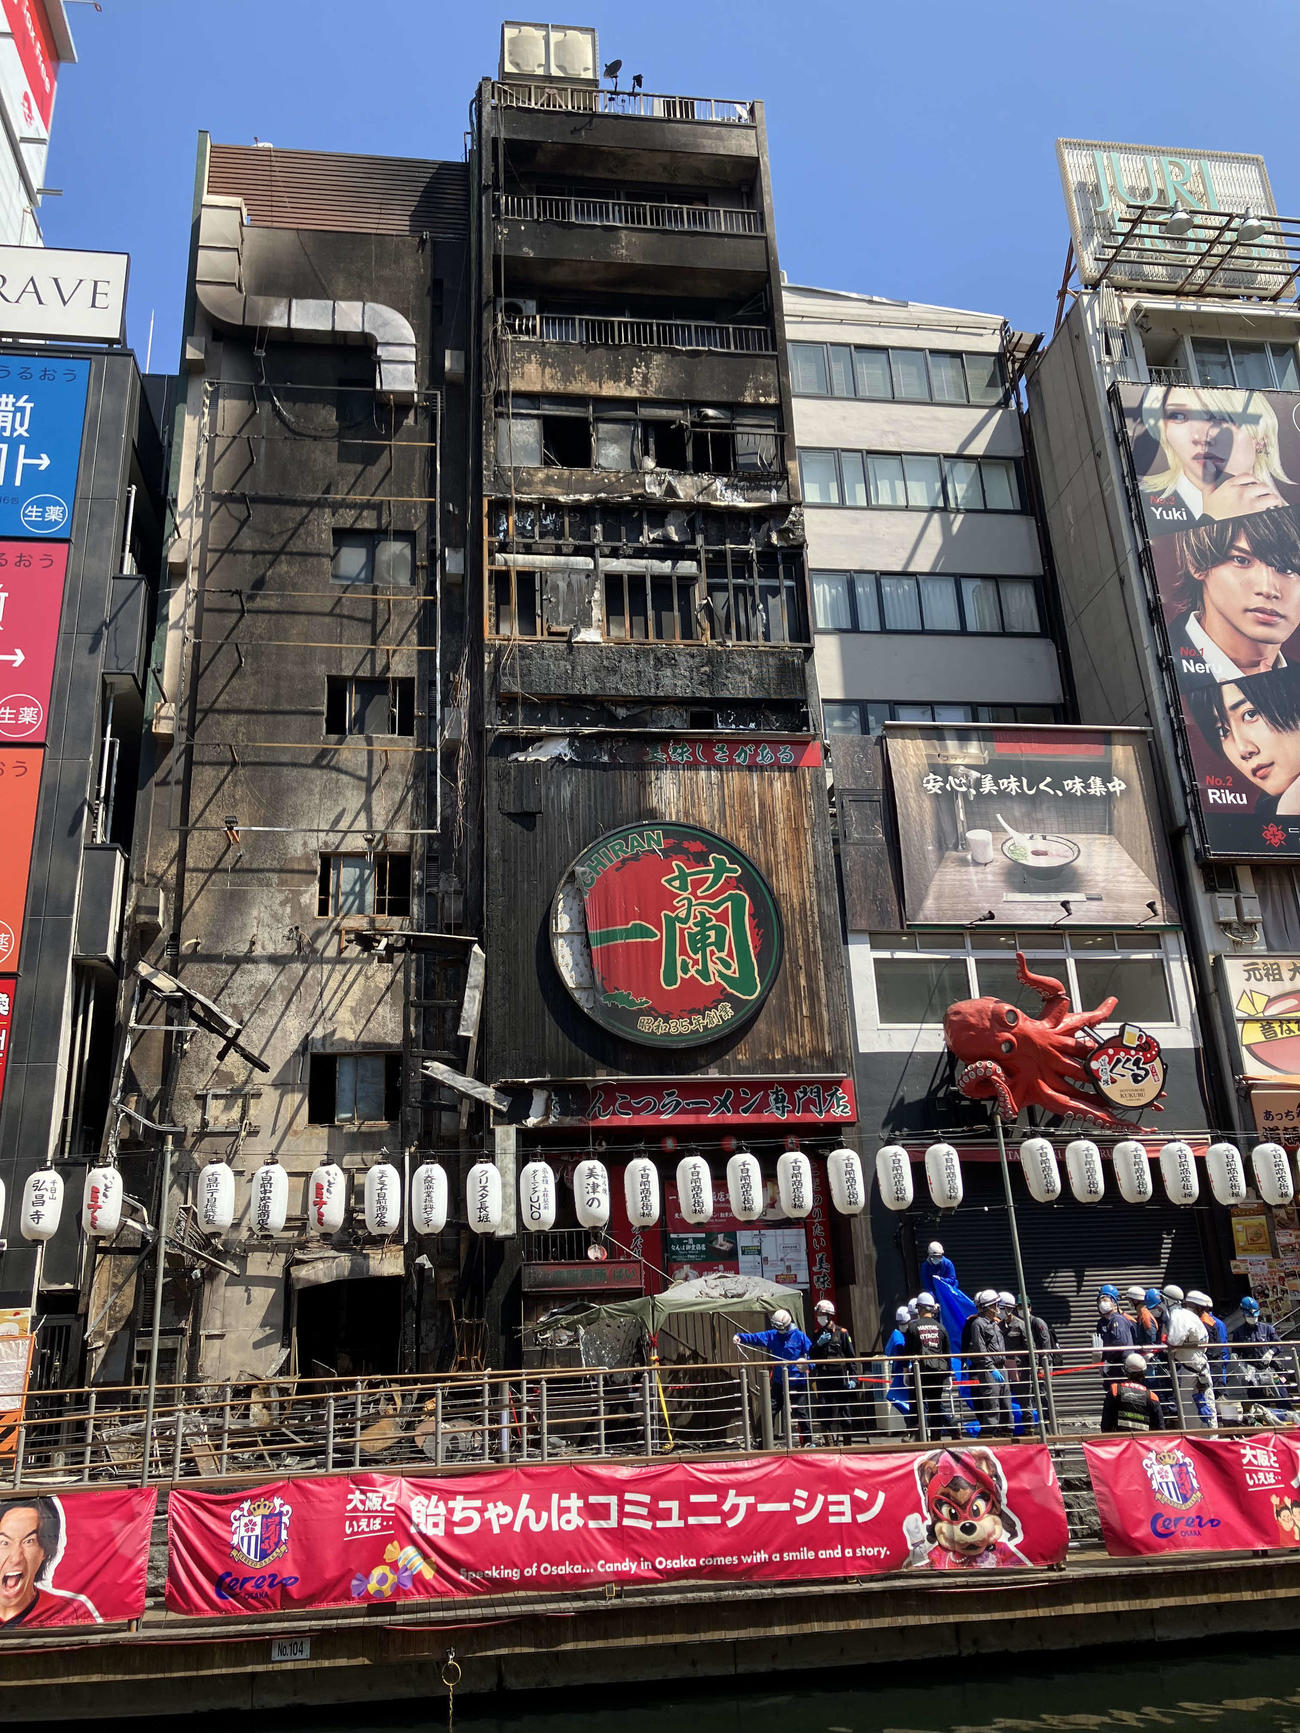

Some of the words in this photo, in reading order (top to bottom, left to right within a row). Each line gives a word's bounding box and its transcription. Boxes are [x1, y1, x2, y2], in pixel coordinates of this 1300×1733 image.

[1093, 150, 1219, 212] JURI
[1150, 506, 1188, 521] Yuki
[1179, 647, 1204, 657] No.1
[1182, 658, 1223, 675] Neru
[922, 772, 1128, 798] 安心、美味しく、味集中
[1205, 775, 1233, 787] No.2
[1207, 788, 1248, 805] Riku
[586, 853, 761, 1000] 一蘭
[1243, 962, 1285, 983] 元祖
[637, 1002, 735, 1036] 昭和35年創業
[1259, 1021, 1300, 1041] 昔な
[1109, 1056, 1150, 1084] くくる
[476, 1169, 492, 1224] クリスタ長堀
[585, 1165, 602, 1209] 美津の
[30, 1179, 49, 1225] 弘昌寺
[1240, 1446, 1279, 1468] 大阪と
[345, 1492, 396, 1513] 大阪と
[408, 1489, 886, 1537] 飴ちゃんはコミュニケーション
[1150, 1512, 1222, 1539] Cerezo
[459, 1563, 522, 1583] Speaking
[524, 1562, 538, 1577] of
[540, 1560, 595, 1577] Osaka...
[597, 1556, 637, 1575] Candy
[640, 1556, 652, 1571] in
[655, 1553, 697, 1570] Osaka
[699, 1553, 739, 1567] comes
[741, 1548, 769, 1564] with
[772, 1552, 780, 1562] a
[783, 1546, 816, 1561] smile
[818, 1543, 842, 1560] and
[844, 1547, 853, 1558] a
[855, 1544, 891, 1561] story.
[214, 1570, 300, 1601] Cerezo
[277, 1643, 304, 1658] No.104
